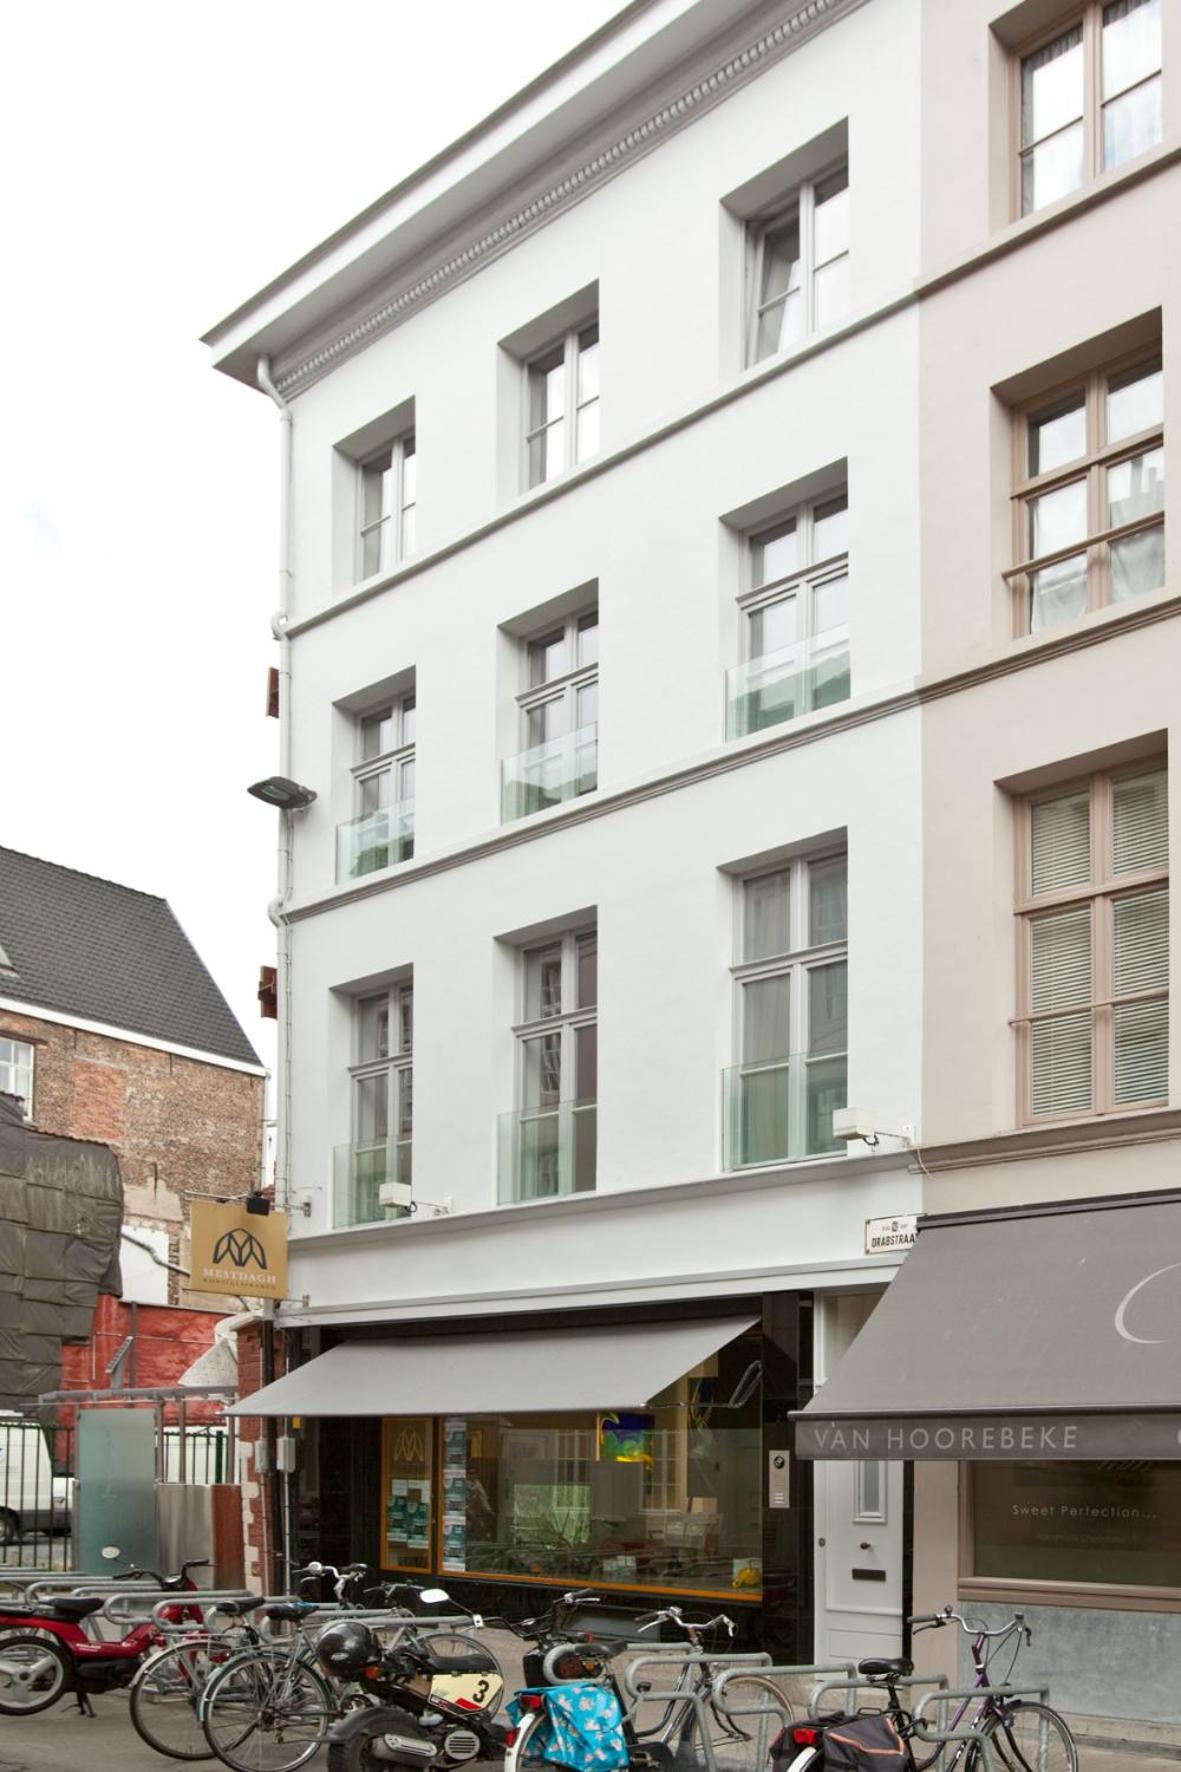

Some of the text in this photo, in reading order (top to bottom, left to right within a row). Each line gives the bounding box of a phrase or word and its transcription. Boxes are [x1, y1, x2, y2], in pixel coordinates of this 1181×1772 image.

[871, 1233, 918, 1248] DRABSTRAA
[203, 1269, 276, 1284] MESTDAGH
[814, 1426, 1078, 1450] VAN HOOREBEKE
[1012, 1504, 1054, 1516] Sweet
[472, 1680, 489, 1702] 3
